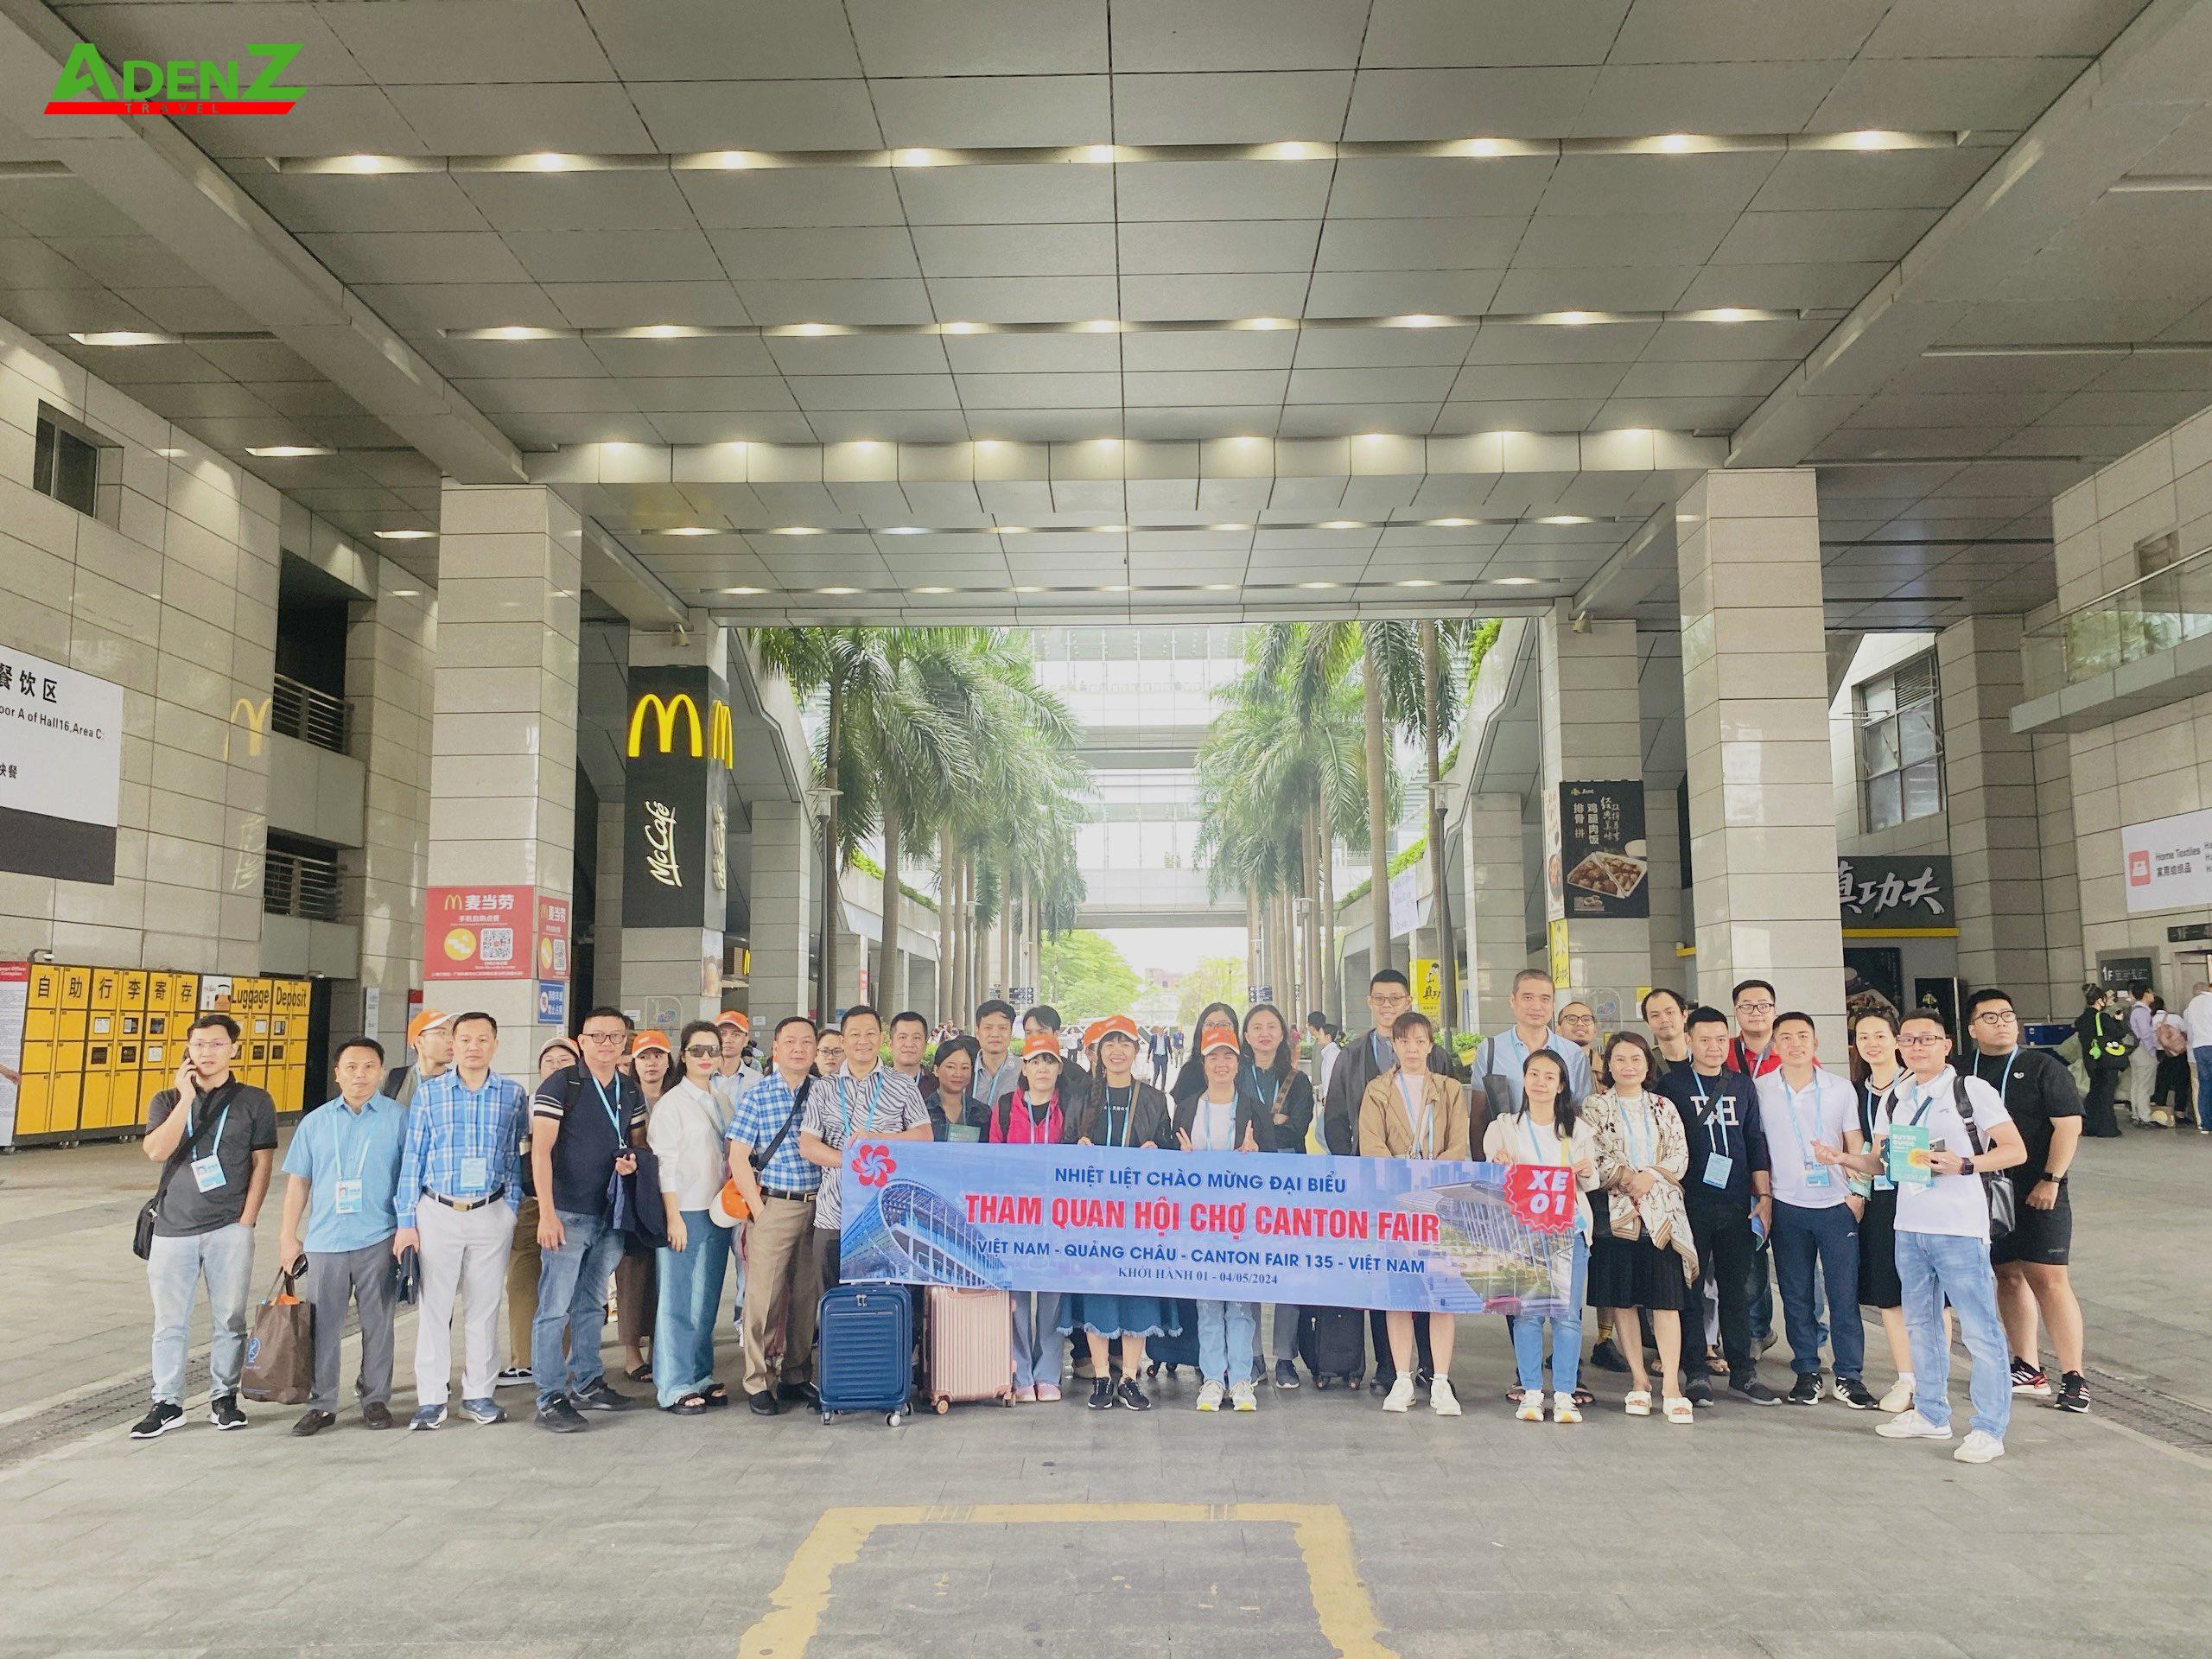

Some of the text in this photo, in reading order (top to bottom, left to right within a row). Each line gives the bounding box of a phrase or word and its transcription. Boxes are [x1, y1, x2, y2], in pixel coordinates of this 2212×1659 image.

[0, 663, 57, 702] 餐饮区
[18, 709, 24, 720] A
[28, 712, 36, 721] of
[2156, 852, 2174, 861] Home
[465, 894, 514, 911] 麦当劳
[38, 976, 192, 1001] 自助行李寄存
[232, 984, 307, 1010] Luggage Deposit
[1055, 1166, 1345, 1194] NHIỆT LIỆT CHÀO MỪNG ĐẠI BIỂU
[1527, 1169, 1570, 1192] XE
[1529, 1192, 1567, 1216] 01
[965, 1195, 1440, 1243] THAM QUAN HỘI CHỢ CANTON FAIR
[977, 1238, 1008, 1257] VIỆT
[1014, 1243, 1050, 1255] NAM
[1065, 1240, 1123, 1259] QUẢNG
[1130, 1244, 1176, 1261] CHÂU
[1191, 1249, 1259, 1265] CANTON
[1265, 1253, 1299, 1267] FAIR
[1306, 1254, 1333, 1268] 135
[1349, 1254, 1381, 1274] VIỆT
[1386, 1259, 1425, 1274] NAM
[1156, 1267, 1192, 1280] HÀNH
[1197, 1271, 1208, 1281] 01
[1219, 1274, 1278, 1285] 04/05/2024
